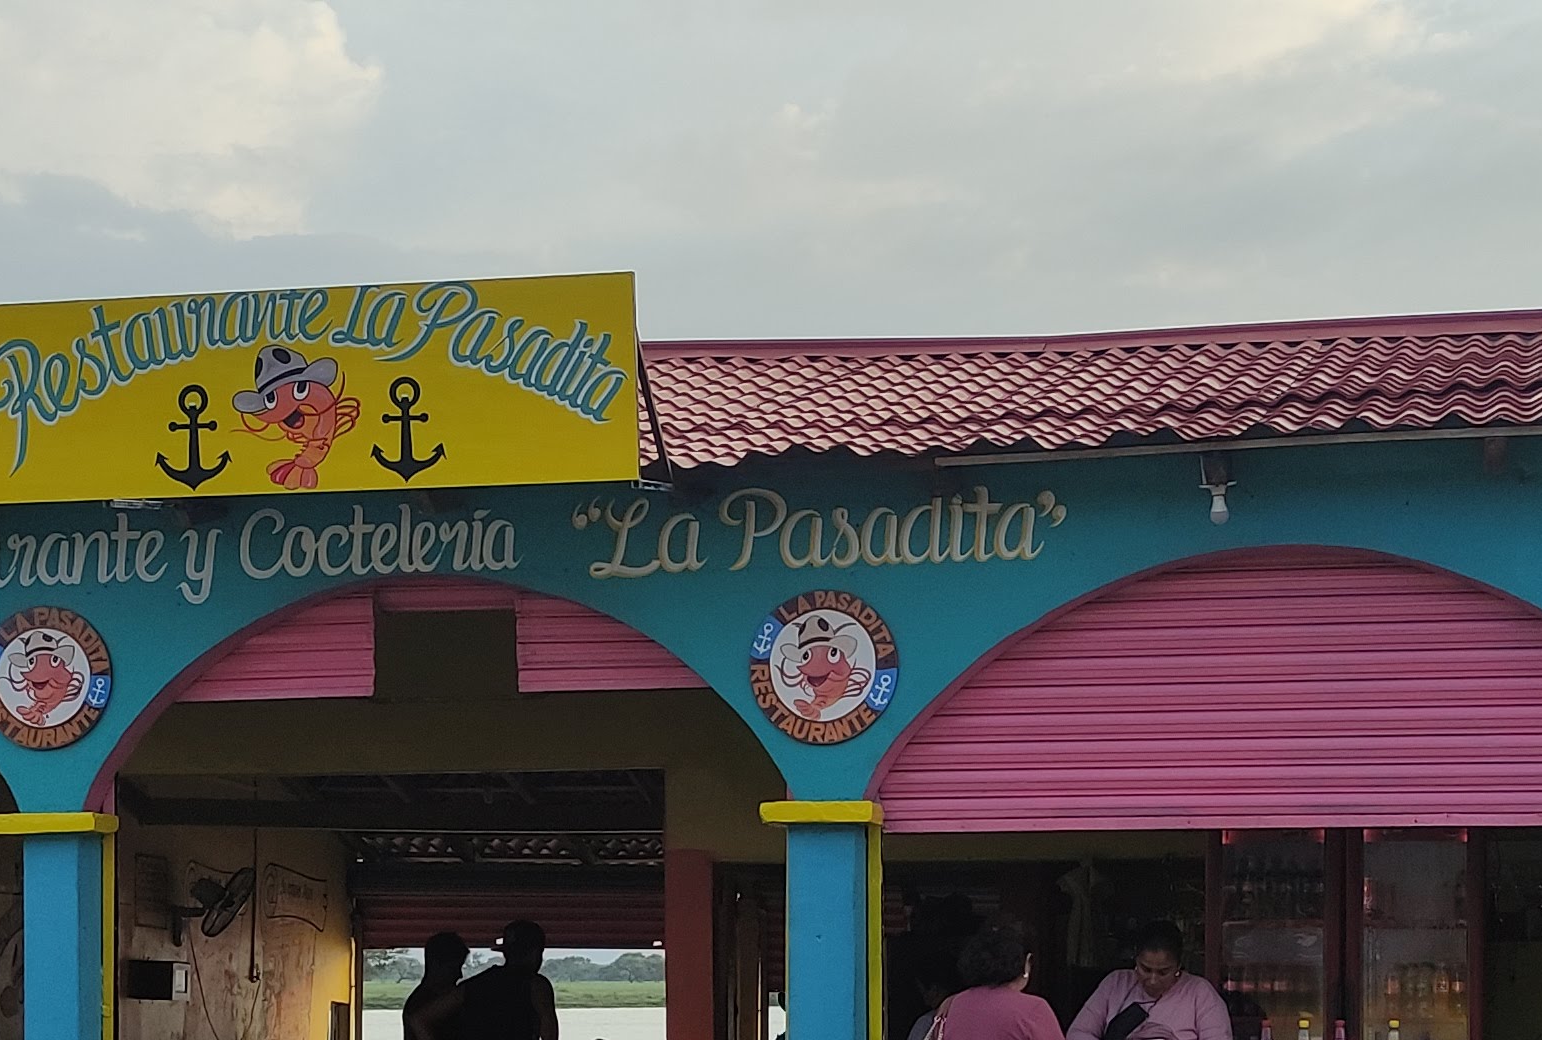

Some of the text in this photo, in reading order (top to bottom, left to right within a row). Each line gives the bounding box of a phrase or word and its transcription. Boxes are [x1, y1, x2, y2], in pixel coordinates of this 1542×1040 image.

[335, 285, 406, 350] La
[373, 281, 628, 424] Pasadita
[178, 527, 221, 605] y
[239, 504, 522, 578] Coctelería
[33, 607, 110, 674] PASADITA
[779, 590, 895, 658] LA PASADITA
[750, 665, 876, 742] RESTAURANTE
